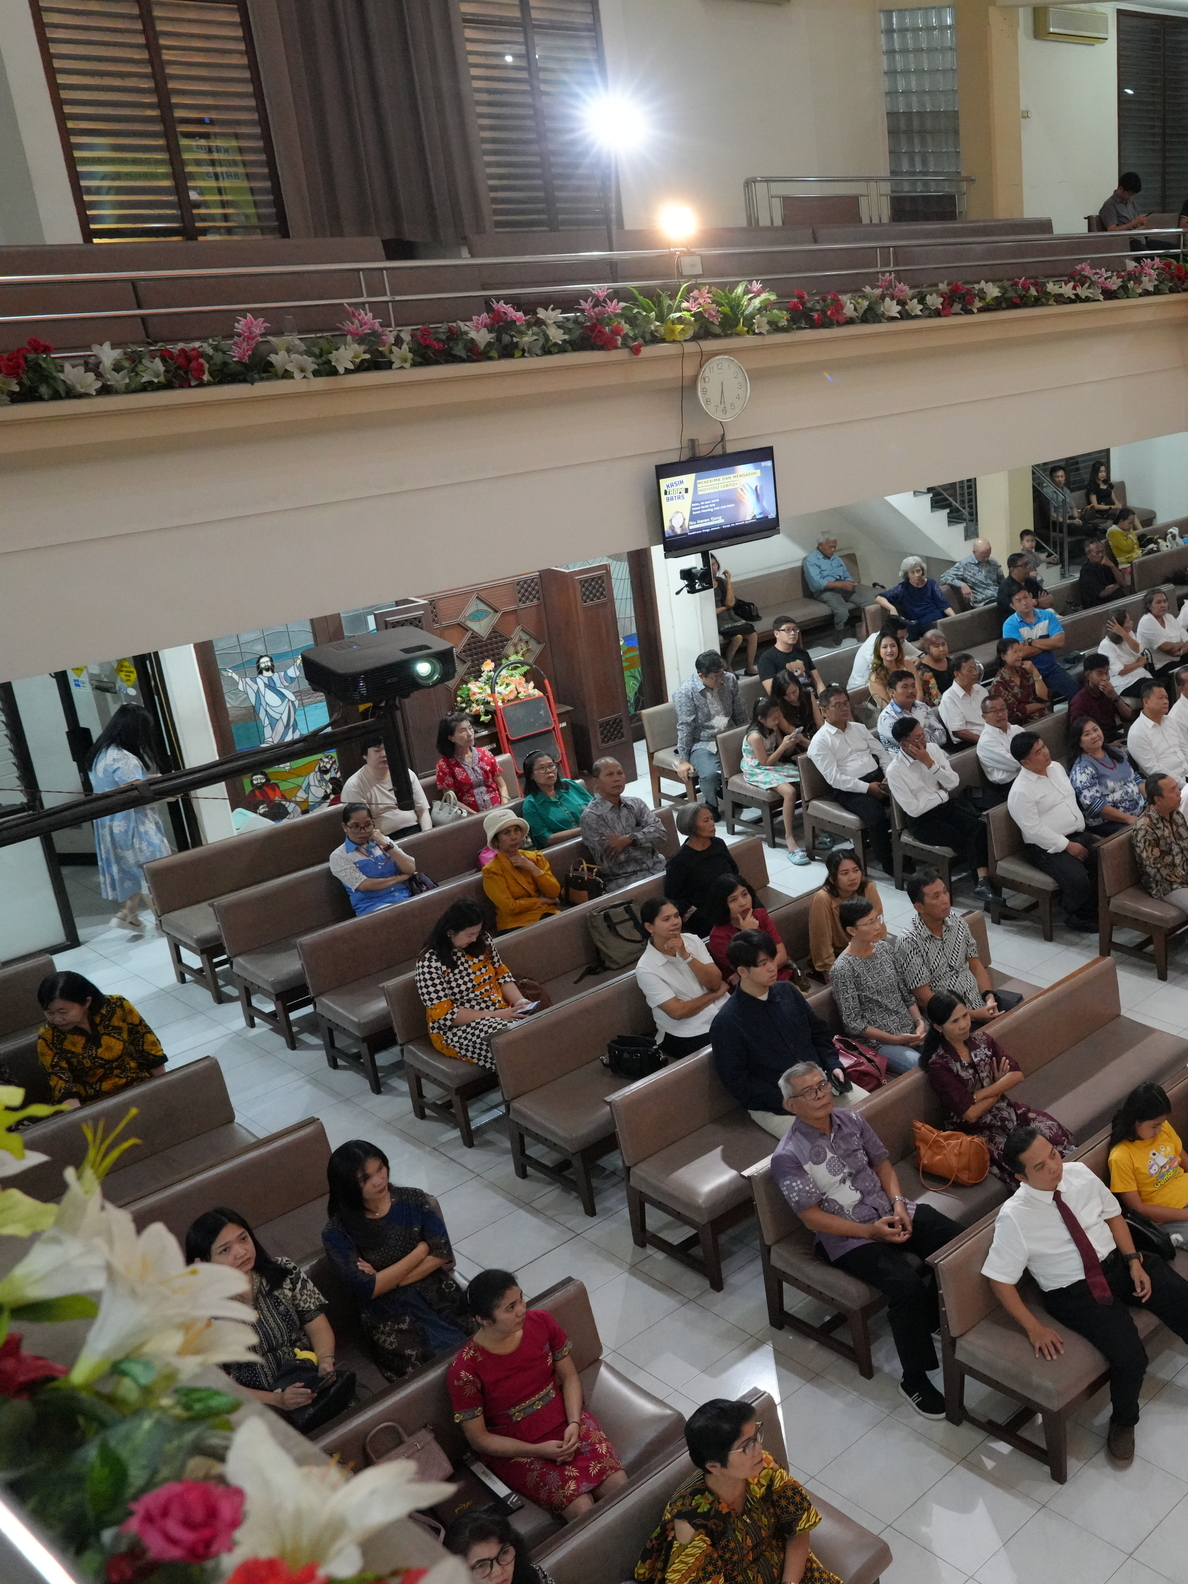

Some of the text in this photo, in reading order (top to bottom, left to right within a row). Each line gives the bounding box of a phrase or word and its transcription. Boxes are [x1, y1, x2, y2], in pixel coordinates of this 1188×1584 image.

[716, 362, 723, 370] 12
[702, 387, 707, 395] 9
[722, 406, 727, 414] 6
[666, 480, 684, 489] KASIH
